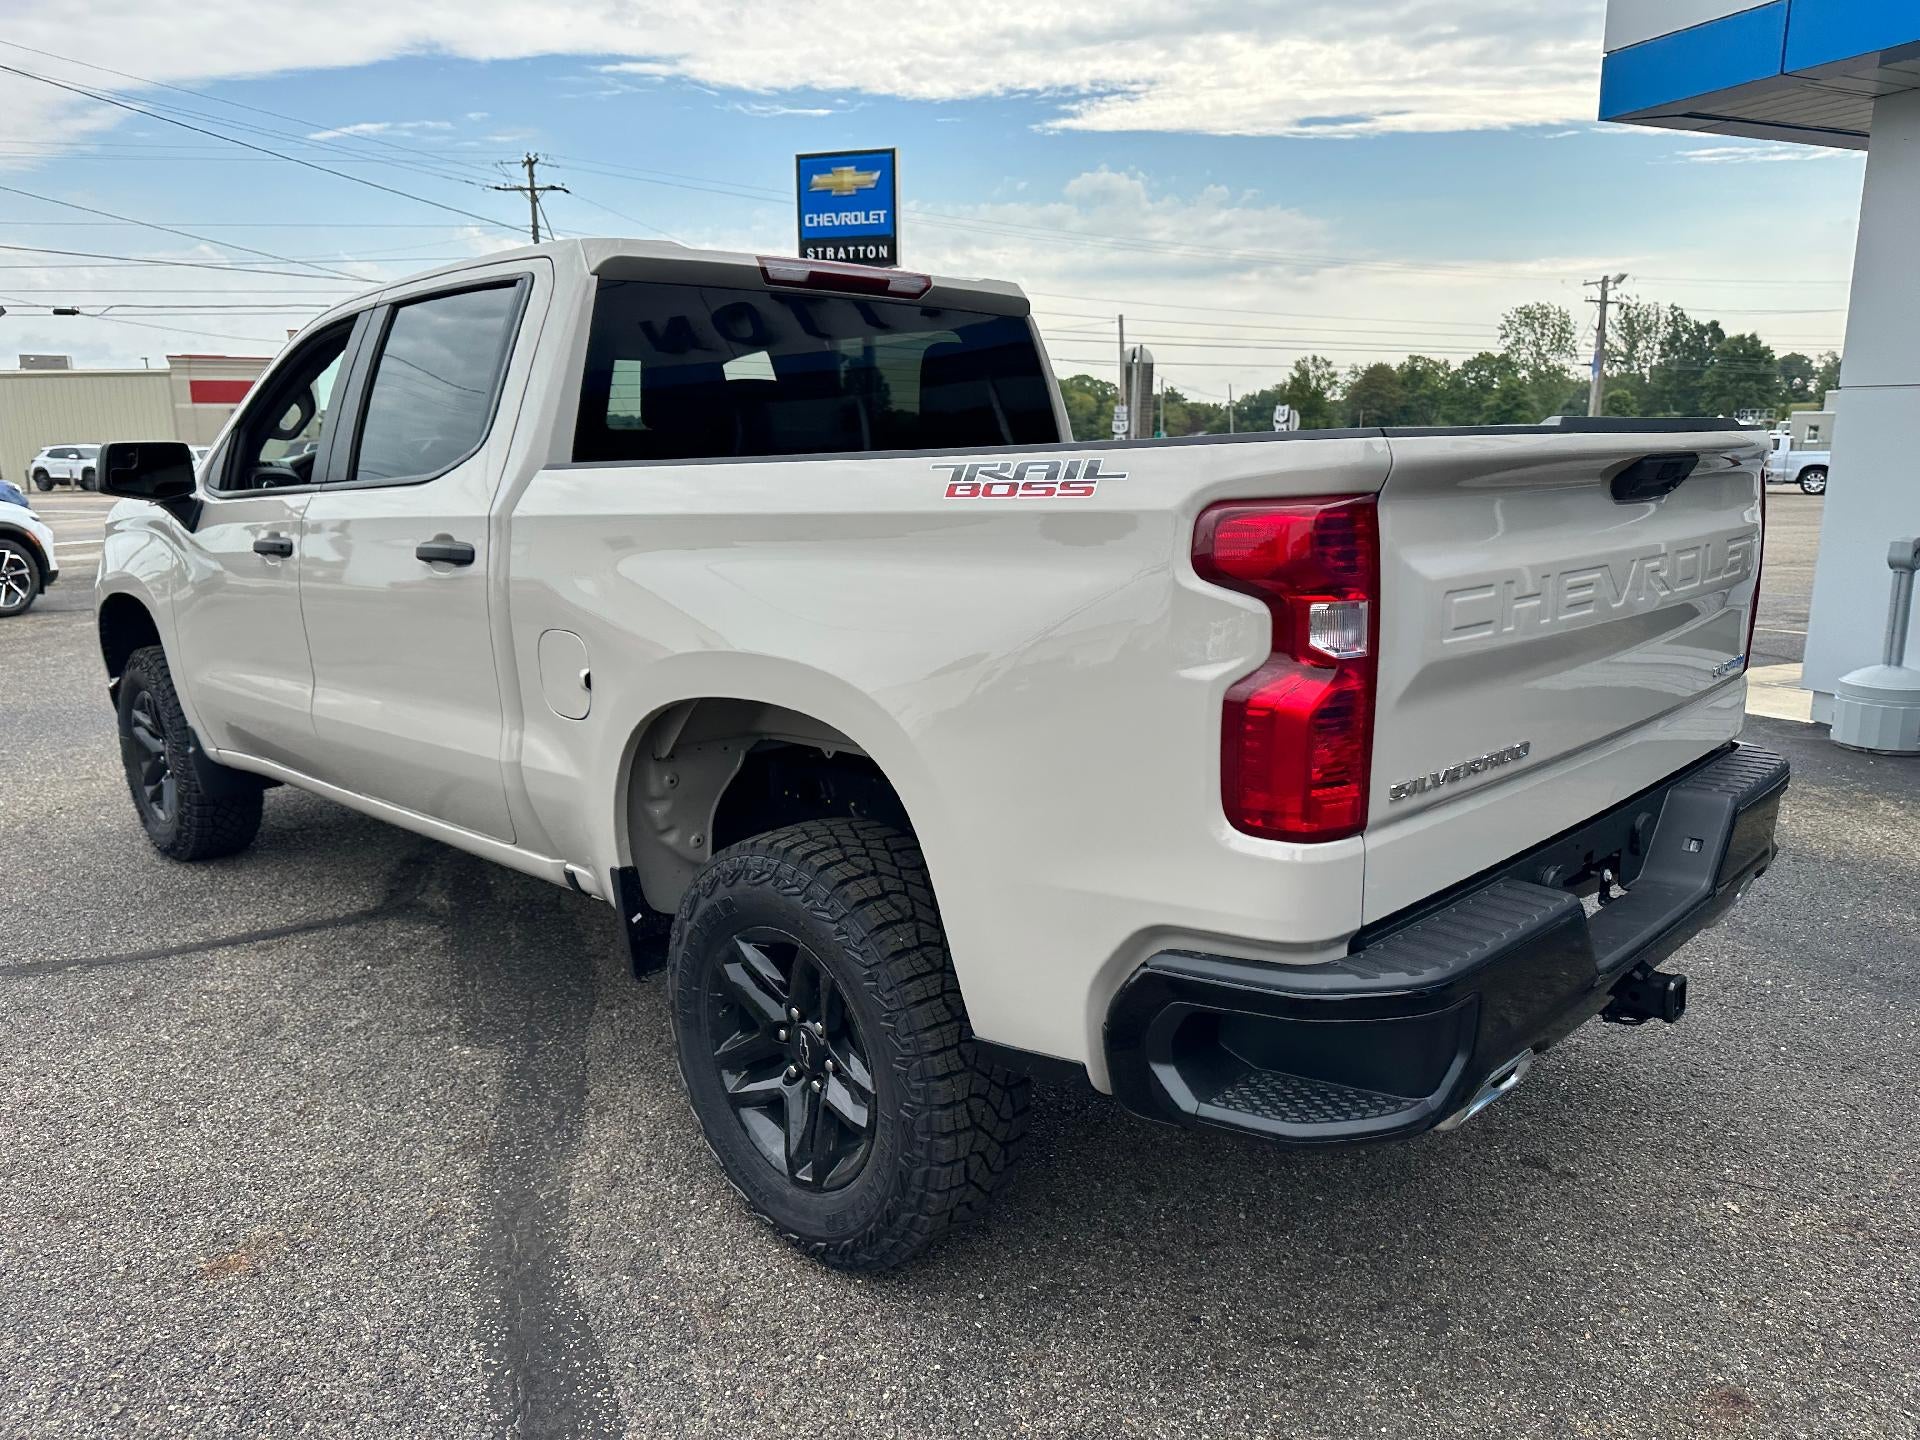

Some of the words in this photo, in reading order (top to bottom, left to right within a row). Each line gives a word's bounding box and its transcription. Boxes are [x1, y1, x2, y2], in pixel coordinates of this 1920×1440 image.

[805, 210, 887, 227] CHEVROLET
[806, 245, 888, 260] STRATTON
[930, 458, 1129, 481] TRAIL
[944, 480, 1098, 499] BOSS
[1441, 534, 1759, 644] CHEVROLET
[1389, 741, 1531, 801] SILVERADO
